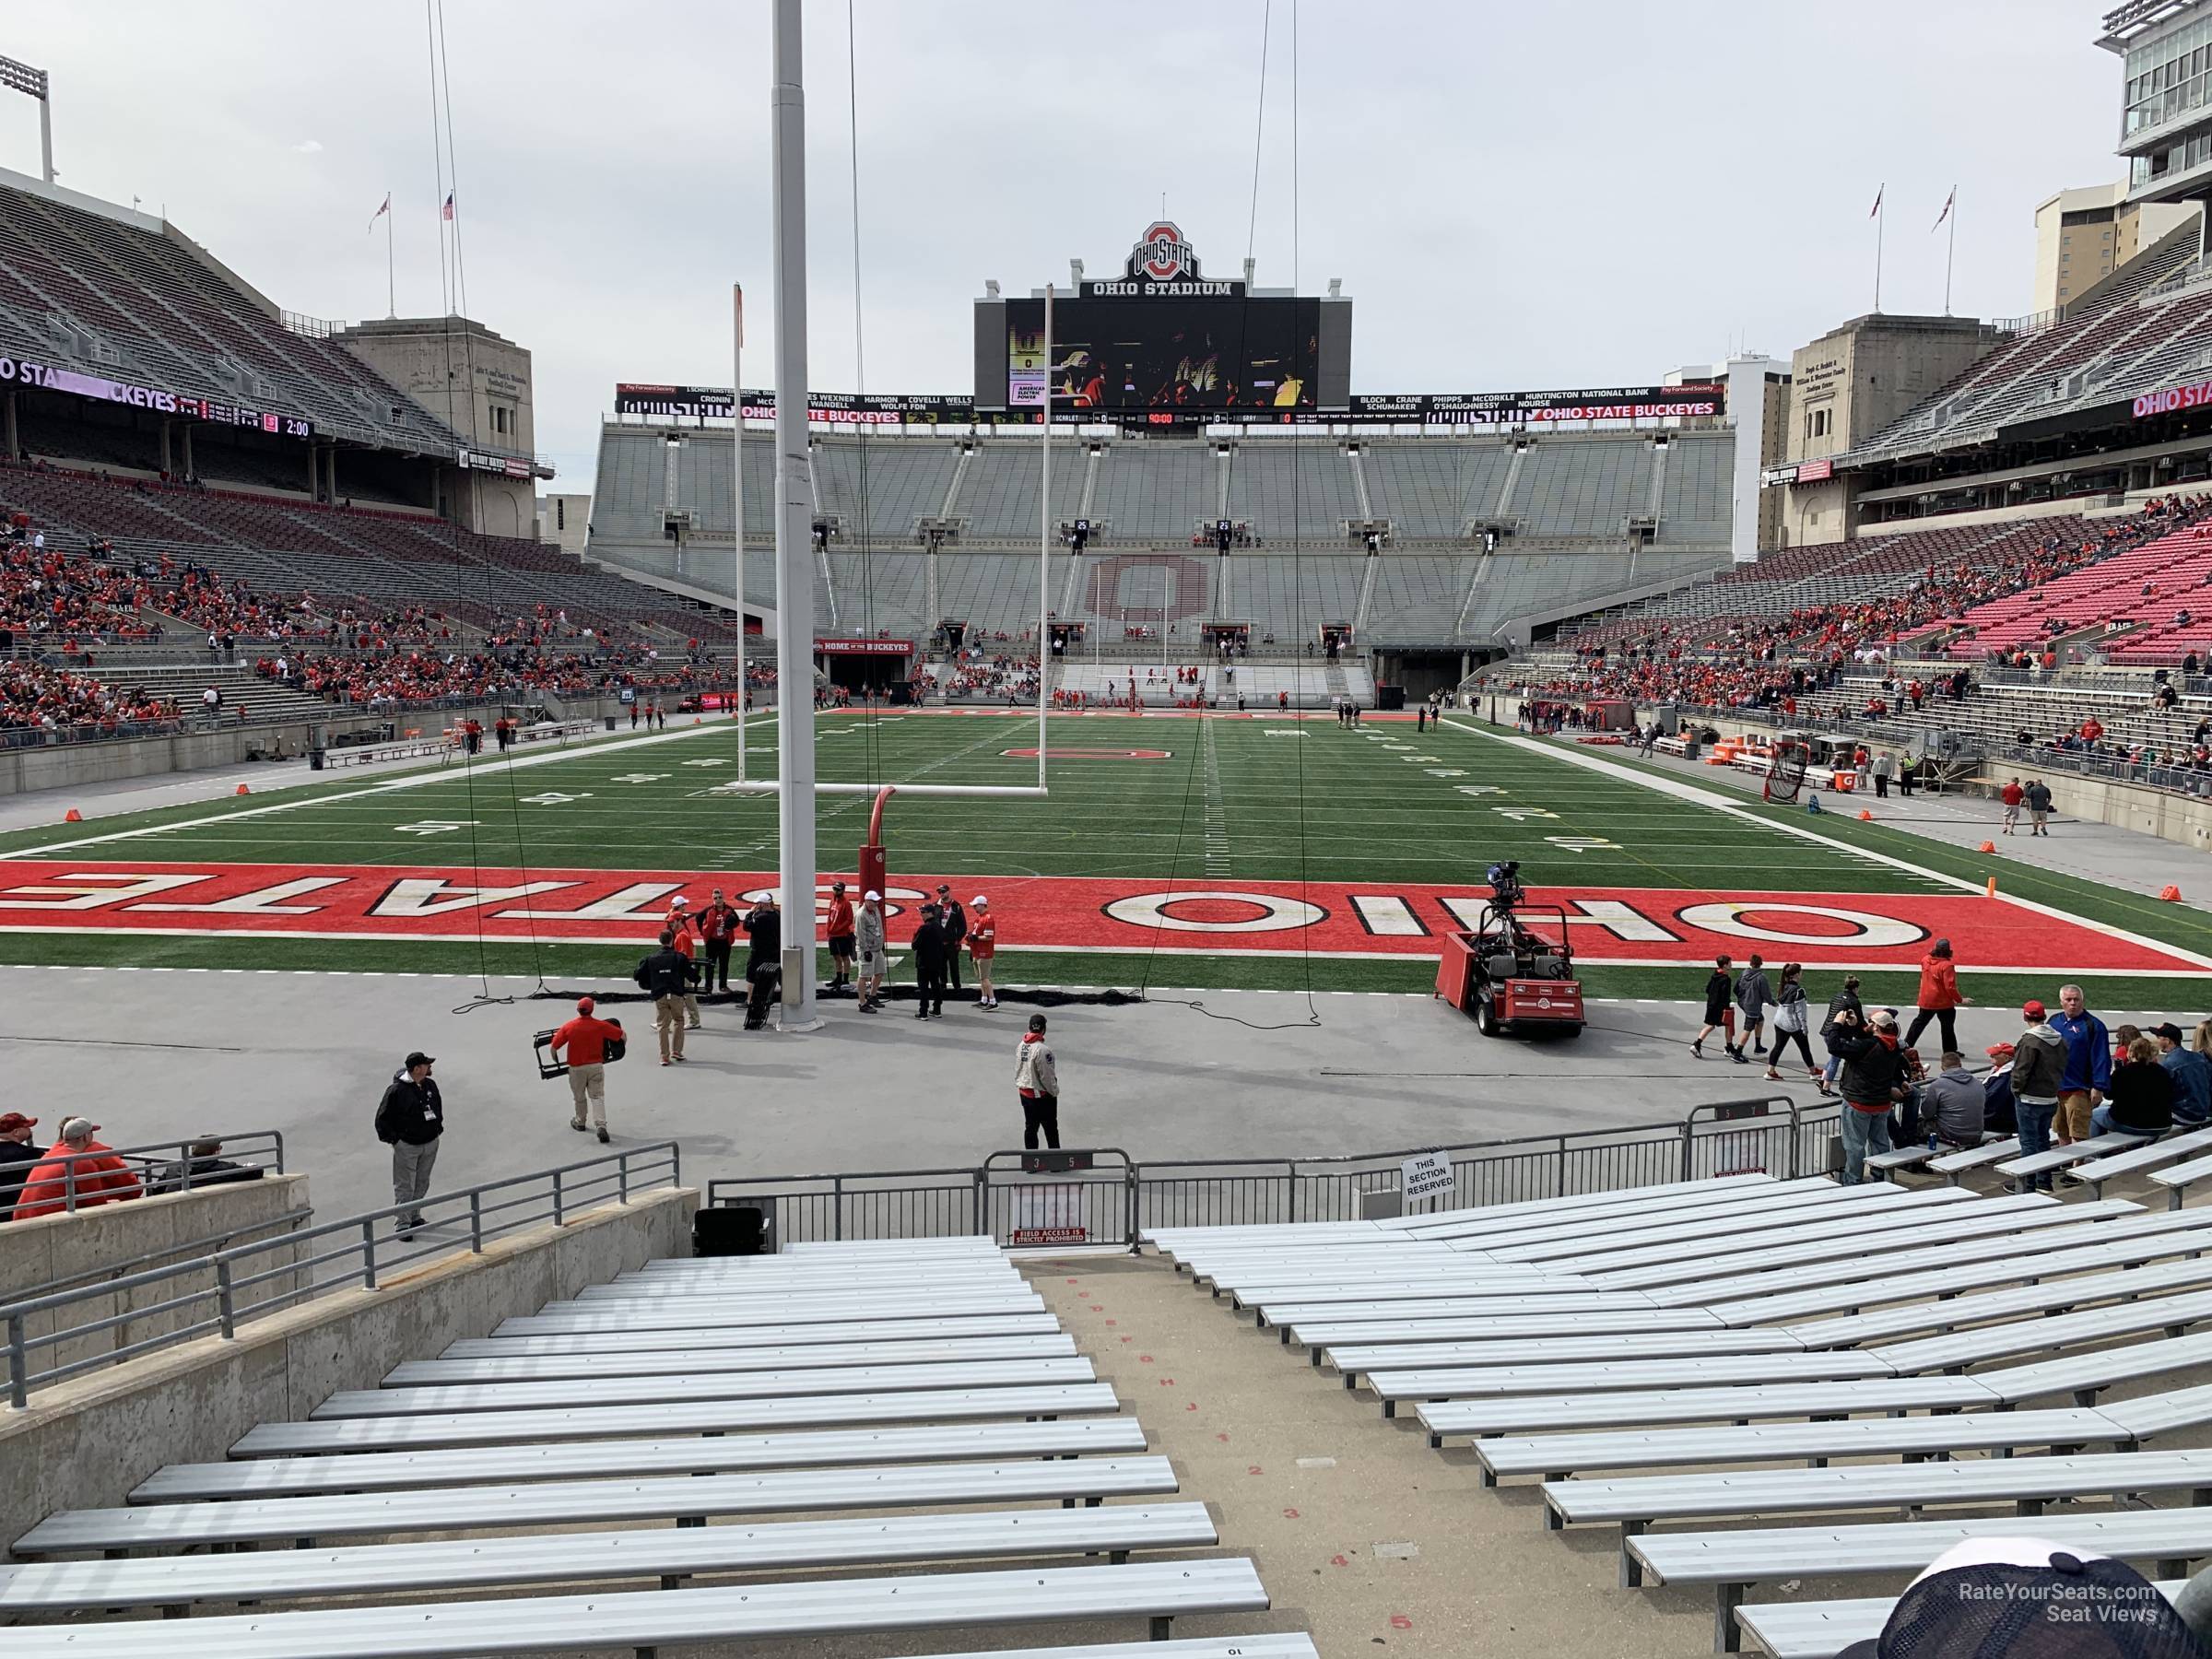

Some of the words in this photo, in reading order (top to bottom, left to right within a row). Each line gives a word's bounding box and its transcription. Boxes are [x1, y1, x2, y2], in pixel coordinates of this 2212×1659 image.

[1135, 242, 1158, 275] OHIO
[1159, 239, 1190, 274] STATE
[1093, 283, 1138, 295] OHIO
[1145, 283, 1232, 295] STADIUM
[700, 395, 730, 404] CRONIN
[819, 394, 855, 403] WEXNER
[1472, 394, 1515, 403] McCORKLE
[1525, 391, 1579, 400] HUNTINGTON
[1582, 389, 1623, 398] NATIONAL
[1625, 388, 1649, 396] BANK
[810, 401, 850, 409] WANDELL
[1518, 399, 1550, 408] NOURSE
[2133, 389, 2181, 418] OHIO
[829, 411, 900, 423] BUCKEYES
[1542, 408, 1583, 420] OHIO
[1585, 405, 1630, 418] STATE
[1634, 403, 1714, 417] BUCKEYES
[1284, 414, 1290, 423] 0
[287, 419, 309, 437] 2:00
[1077, 521, 1087, 530] 25
[1844, 776, 1853, 785] G
[1034, 1158, 1040, 1169] 3
[1069, 1157, 1075, 1167] 5
[1415, 1158, 1435, 1171] THIS
[1408, 1167, 1447, 1183] SECTION
[1407, 1177, 1453, 1196] RESERVED
[1045, 1235, 1084, 1243] PROHIBITED
[1248, 1465, 1264, 1476] 2
[1283, 1508, 1300, 1520] 3
[1330, 1555, 1349, 1567] 4
[1390, 1615, 1413, 1630] 5
